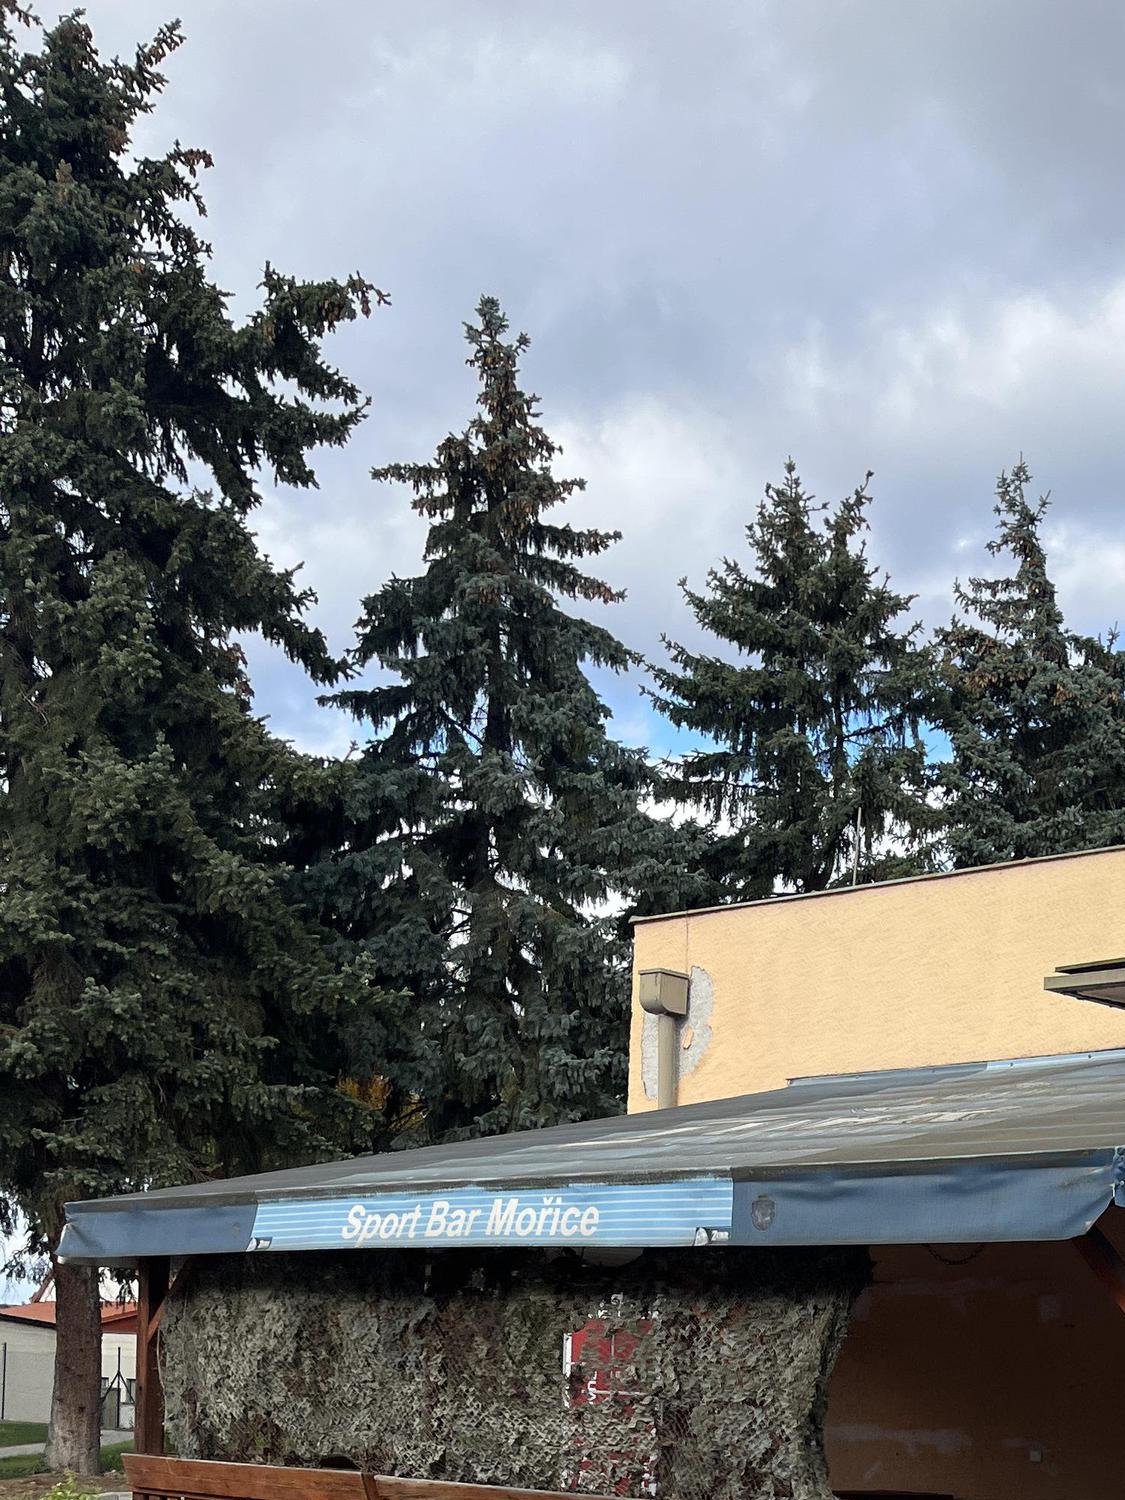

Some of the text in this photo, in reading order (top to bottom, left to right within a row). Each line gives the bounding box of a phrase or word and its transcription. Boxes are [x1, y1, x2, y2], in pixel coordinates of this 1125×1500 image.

[341, 1195, 600, 1248] Sport Bar Mořice
